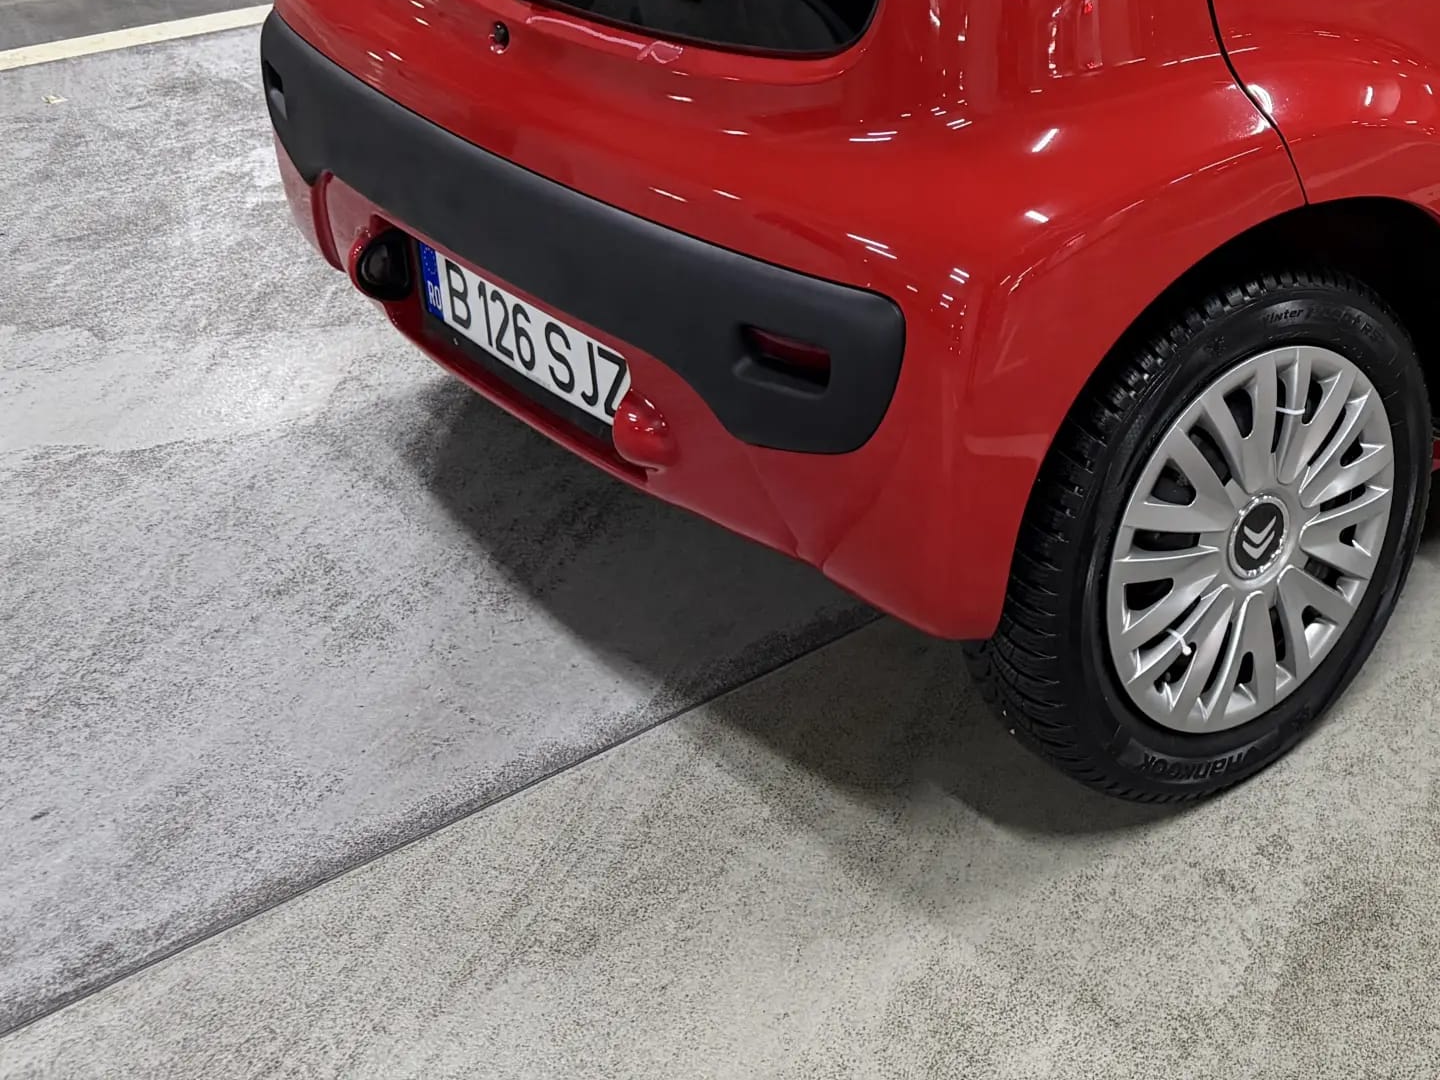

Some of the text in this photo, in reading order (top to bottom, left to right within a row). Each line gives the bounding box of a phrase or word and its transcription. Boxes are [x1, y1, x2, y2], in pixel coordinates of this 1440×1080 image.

[427, 280, 442, 311] RO
[444, 258, 628, 418] B 126 SJZ
